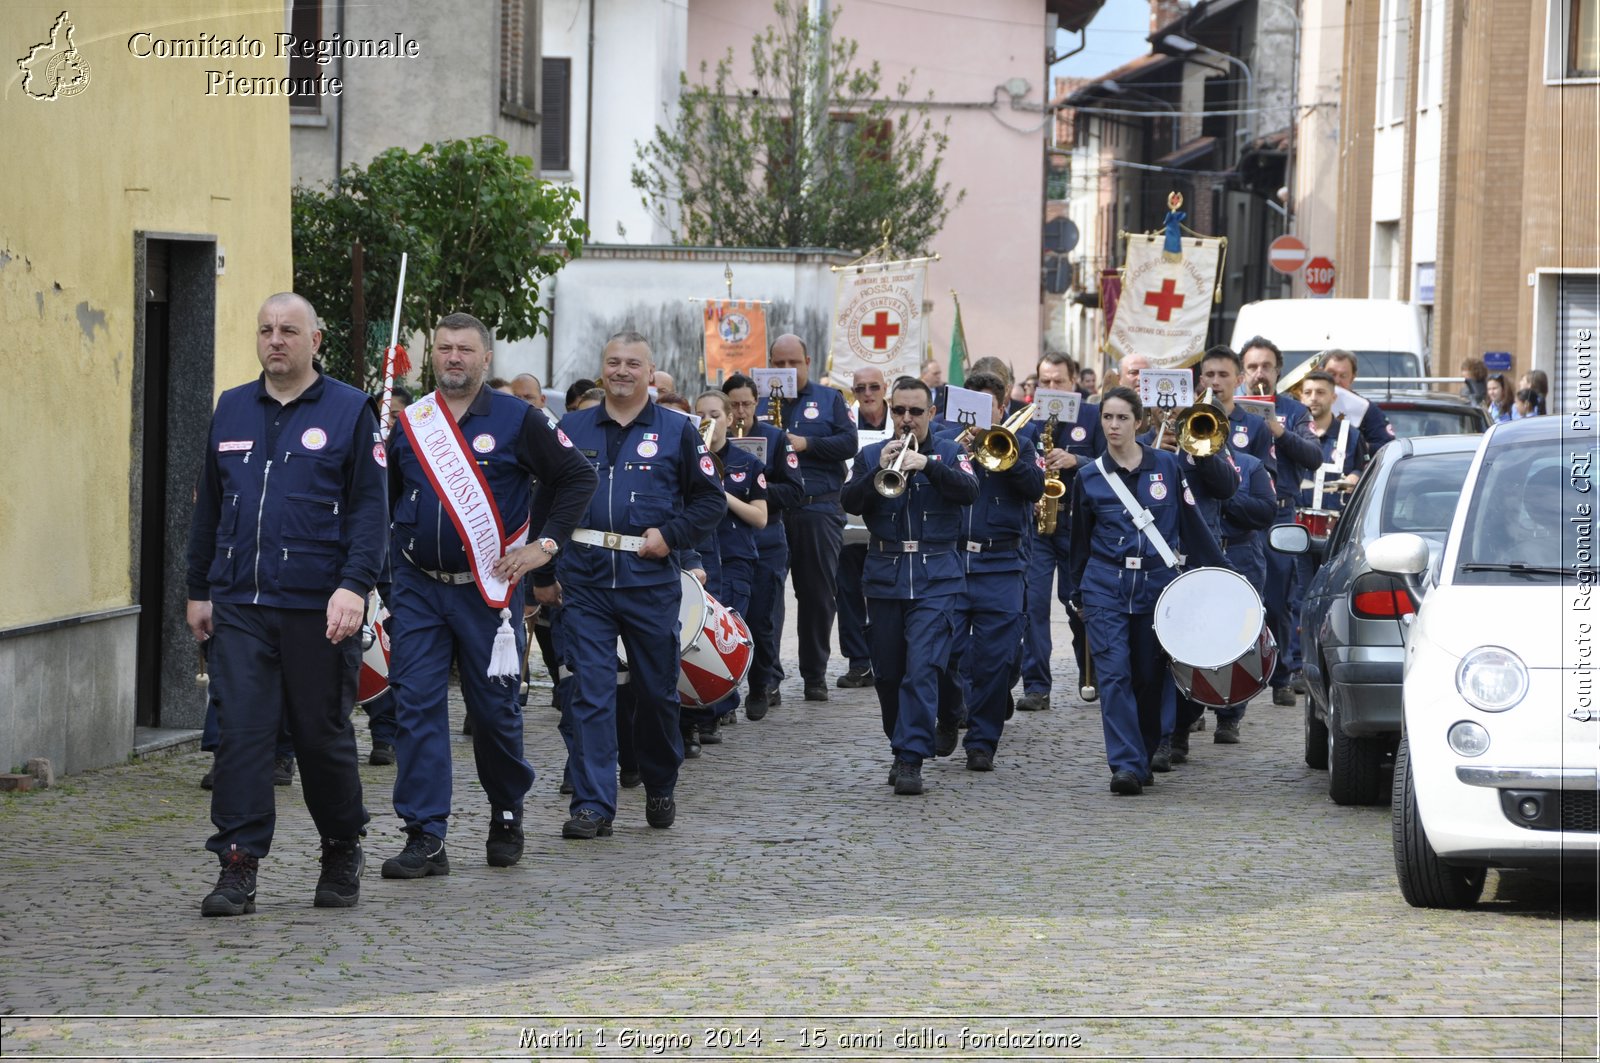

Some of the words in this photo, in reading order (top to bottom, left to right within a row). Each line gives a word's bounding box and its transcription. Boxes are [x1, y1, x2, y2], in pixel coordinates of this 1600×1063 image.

[1306, 267, 1335, 284] STOP
[860, 284, 893, 298] ROSSA
[424, 429, 460, 473] CROCE
[444, 467, 483, 517] ROSSA
[468, 511, 498, 581] ITALIANA
